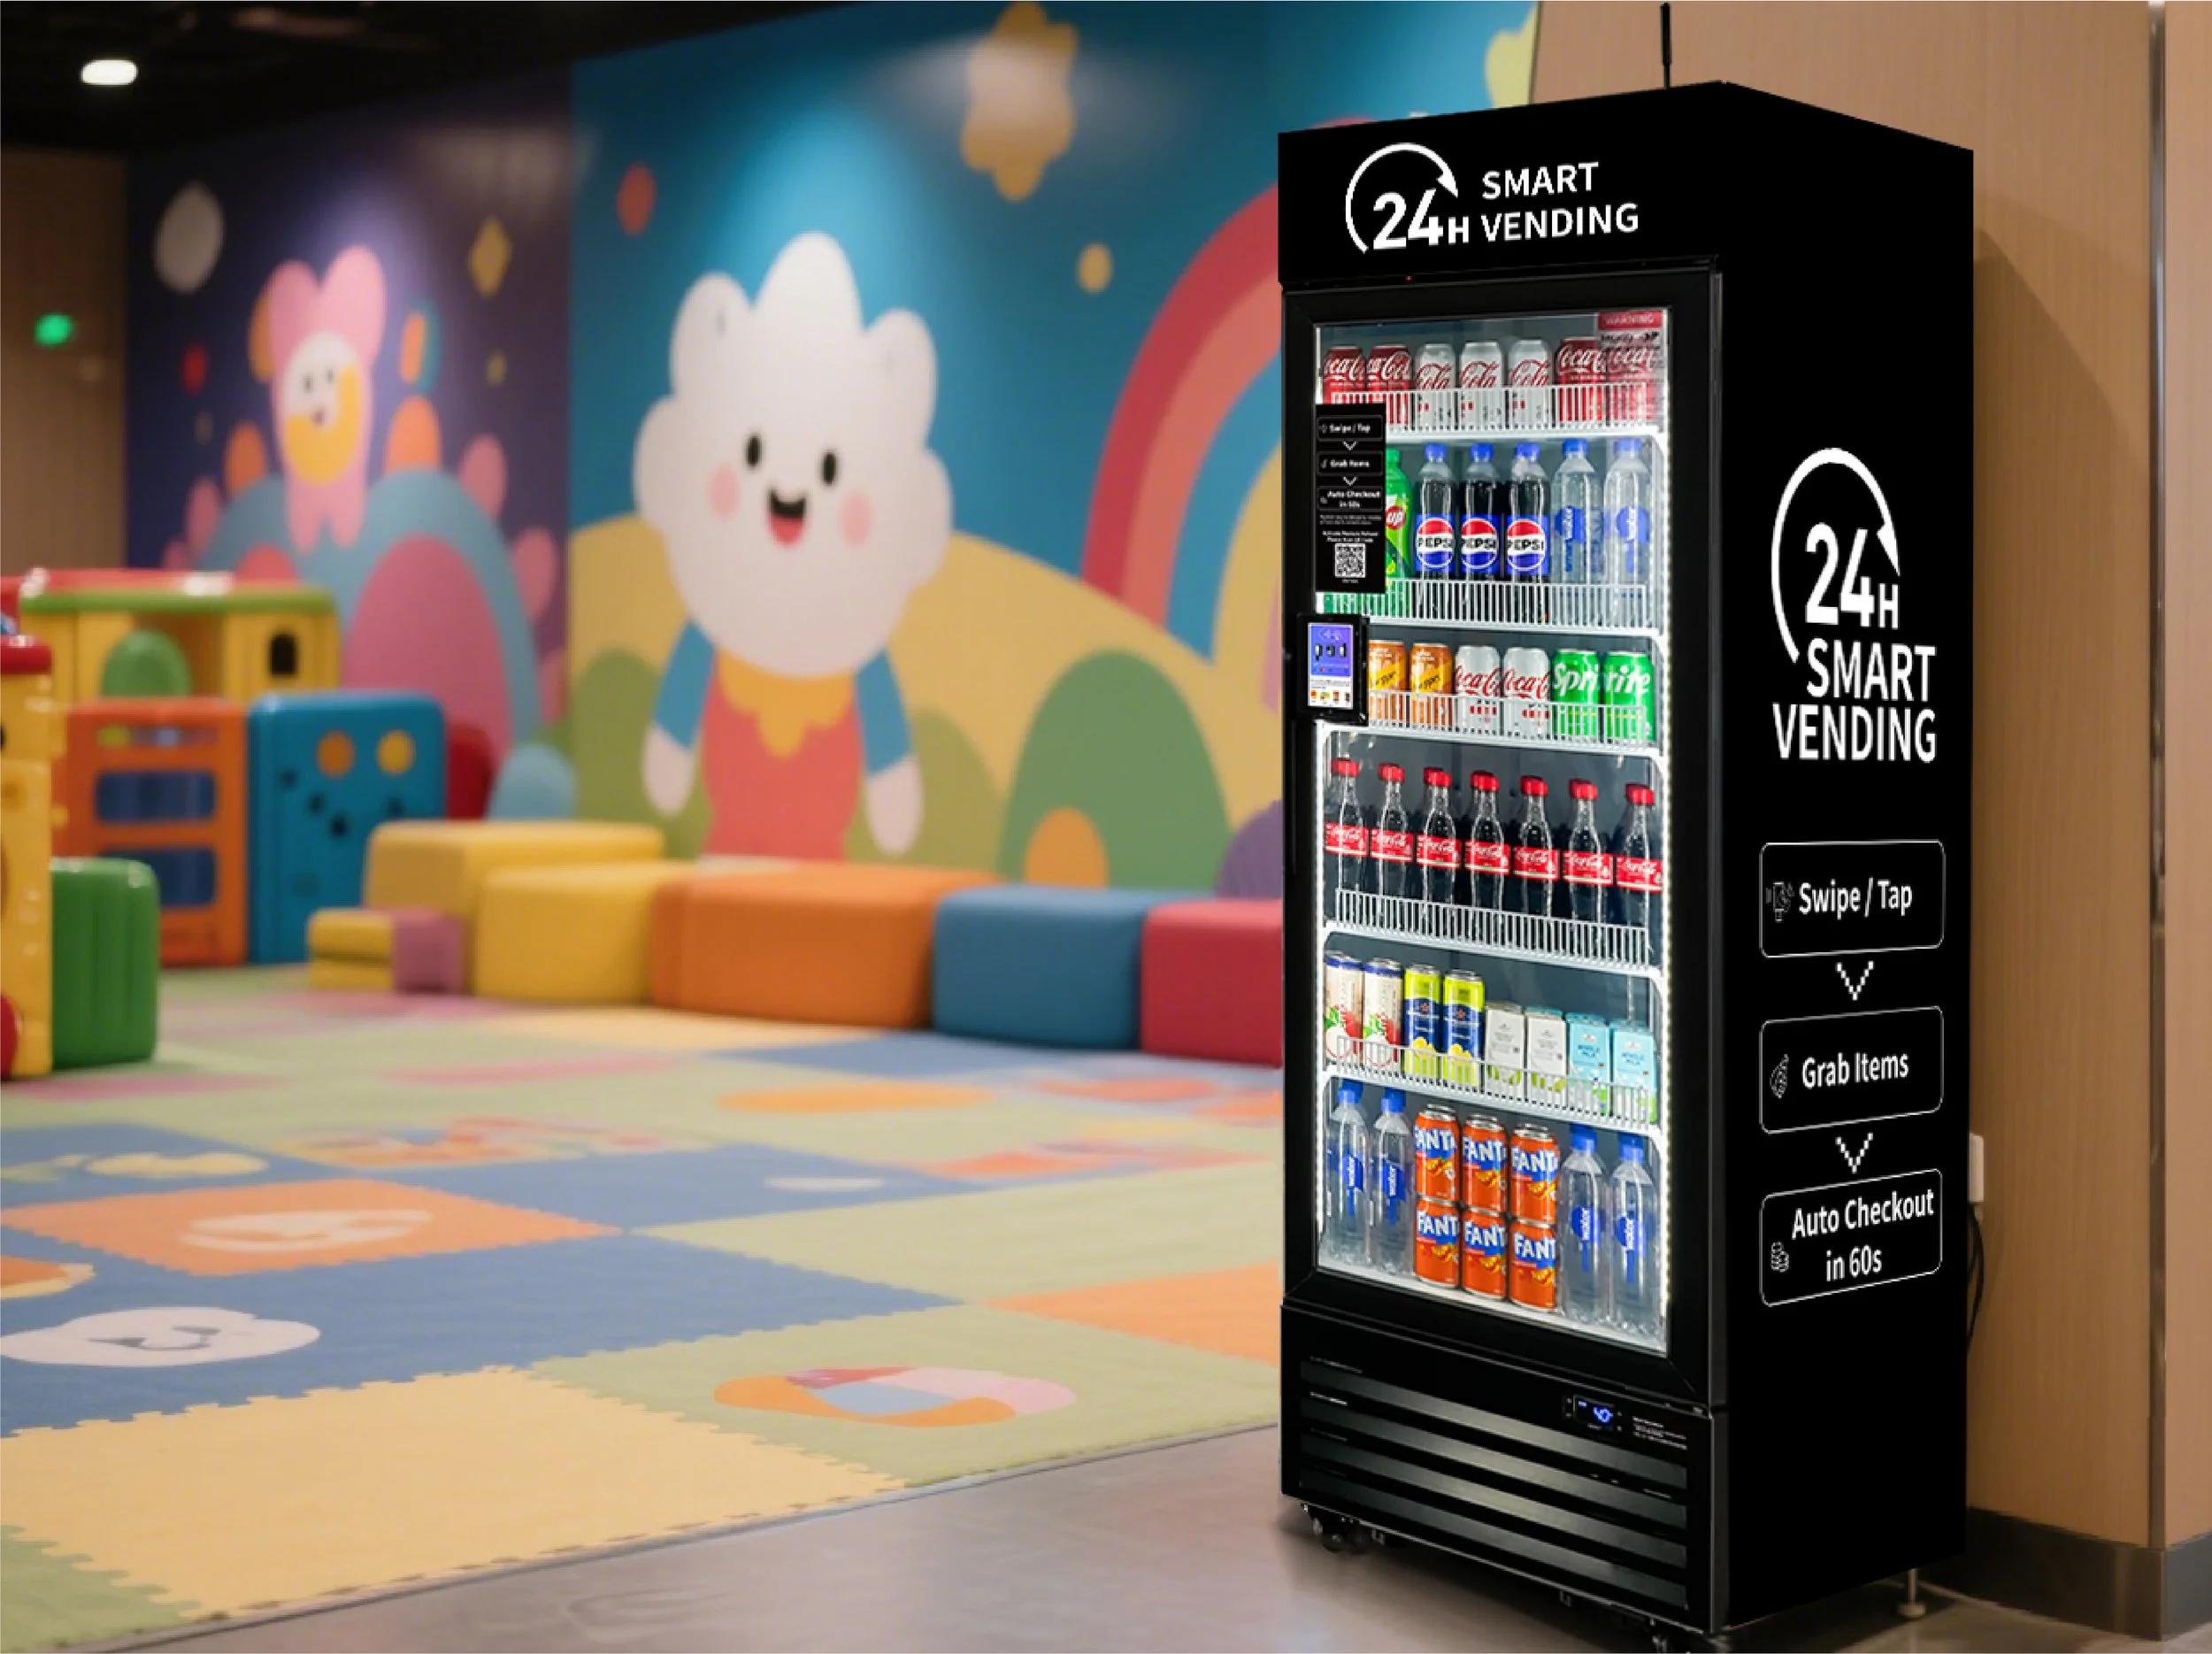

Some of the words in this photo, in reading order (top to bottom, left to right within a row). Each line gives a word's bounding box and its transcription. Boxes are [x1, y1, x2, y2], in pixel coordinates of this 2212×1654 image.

[1483, 162, 1598, 199] SMART
[1481, 203, 1639, 242] VENDING
[1554, 661, 1599, 696] Spri
[1606, 664, 1651, 695] rite
[1807, 638, 1935, 702] SMART
[1773, 703, 1935, 763] VENDING
[1800, 879, 1861, 919] Swipe
[1865, 878, 1873, 917] /
[1878, 880, 1912, 916] Tap
[1802, 1052, 1849, 1089] Grab
[1856, 1052, 1909, 1082] Items
[1417, 1210, 1458, 1236] FANT
[1792, 1207, 1839, 1240] Auto
[1845, 1189, 1933, 1229] Checkout
[1464, 1220, 1507, 1247] FANT
[1514, 1232, 1556, 1259] FANT
[1827, 1250, 1845, 1281] in
[1850, 1247, 1882, 1275] 60s
